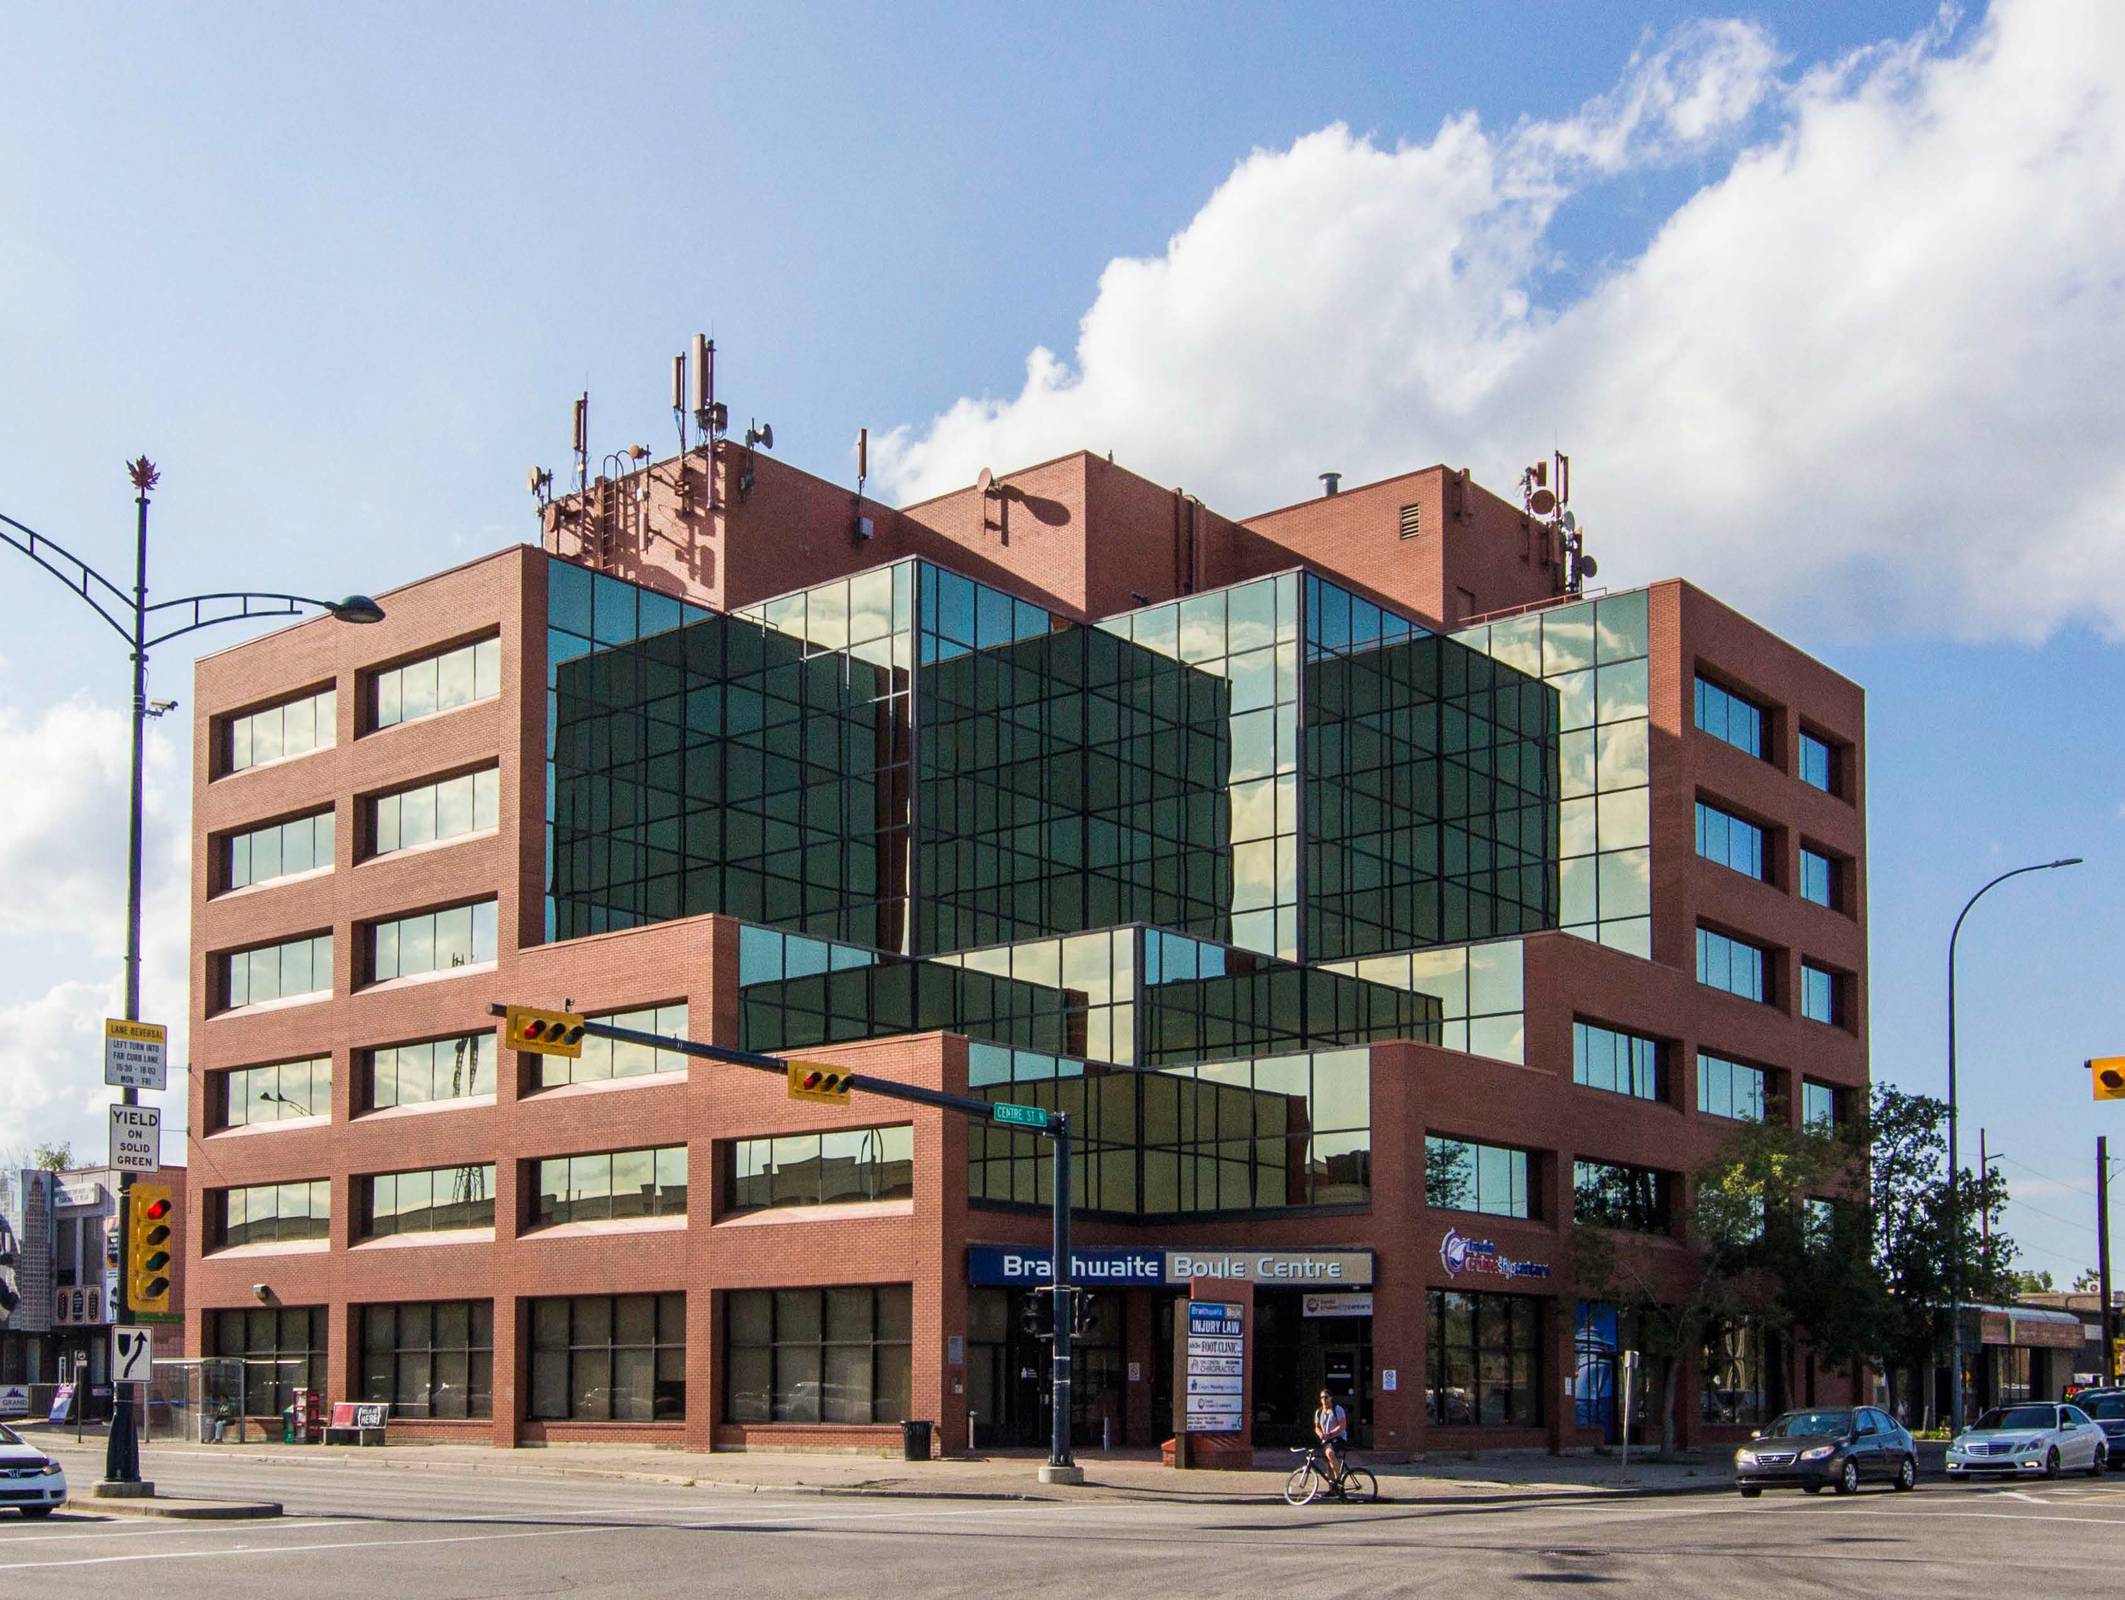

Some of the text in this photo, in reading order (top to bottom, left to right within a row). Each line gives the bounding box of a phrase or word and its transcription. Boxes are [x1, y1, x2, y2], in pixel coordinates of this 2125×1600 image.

[111, 1024, 163, 1038] LANE REVERSAL
[113, 1040, 159, 1052] LEFT TURN INTO
[113, 1051, 158, 1063] FAR CURB LANE
[120, 1075, 134, 1084] MON
[142, 1077, 152, 1085] FRI
[113, 1111, 158, 1126] YIELD
[997, 1106, 1024, 1120] CENTRE
[1026, 1111, 1035, 1121] ST
[128, 1130, 142, 1139] ON
[120, 1142, 150, 1153] SOLID
[117, 1155, 152, 1166] GREEN
[1003, 1255, 1342, 1279] Brahwaite Boyle Centre
[1192, 1319, 1240, 1333] INJURY LAW
[1201, 1341, 1217, 1353] FOOT
[1218, 1341, 1238, 1354] CLINIC
